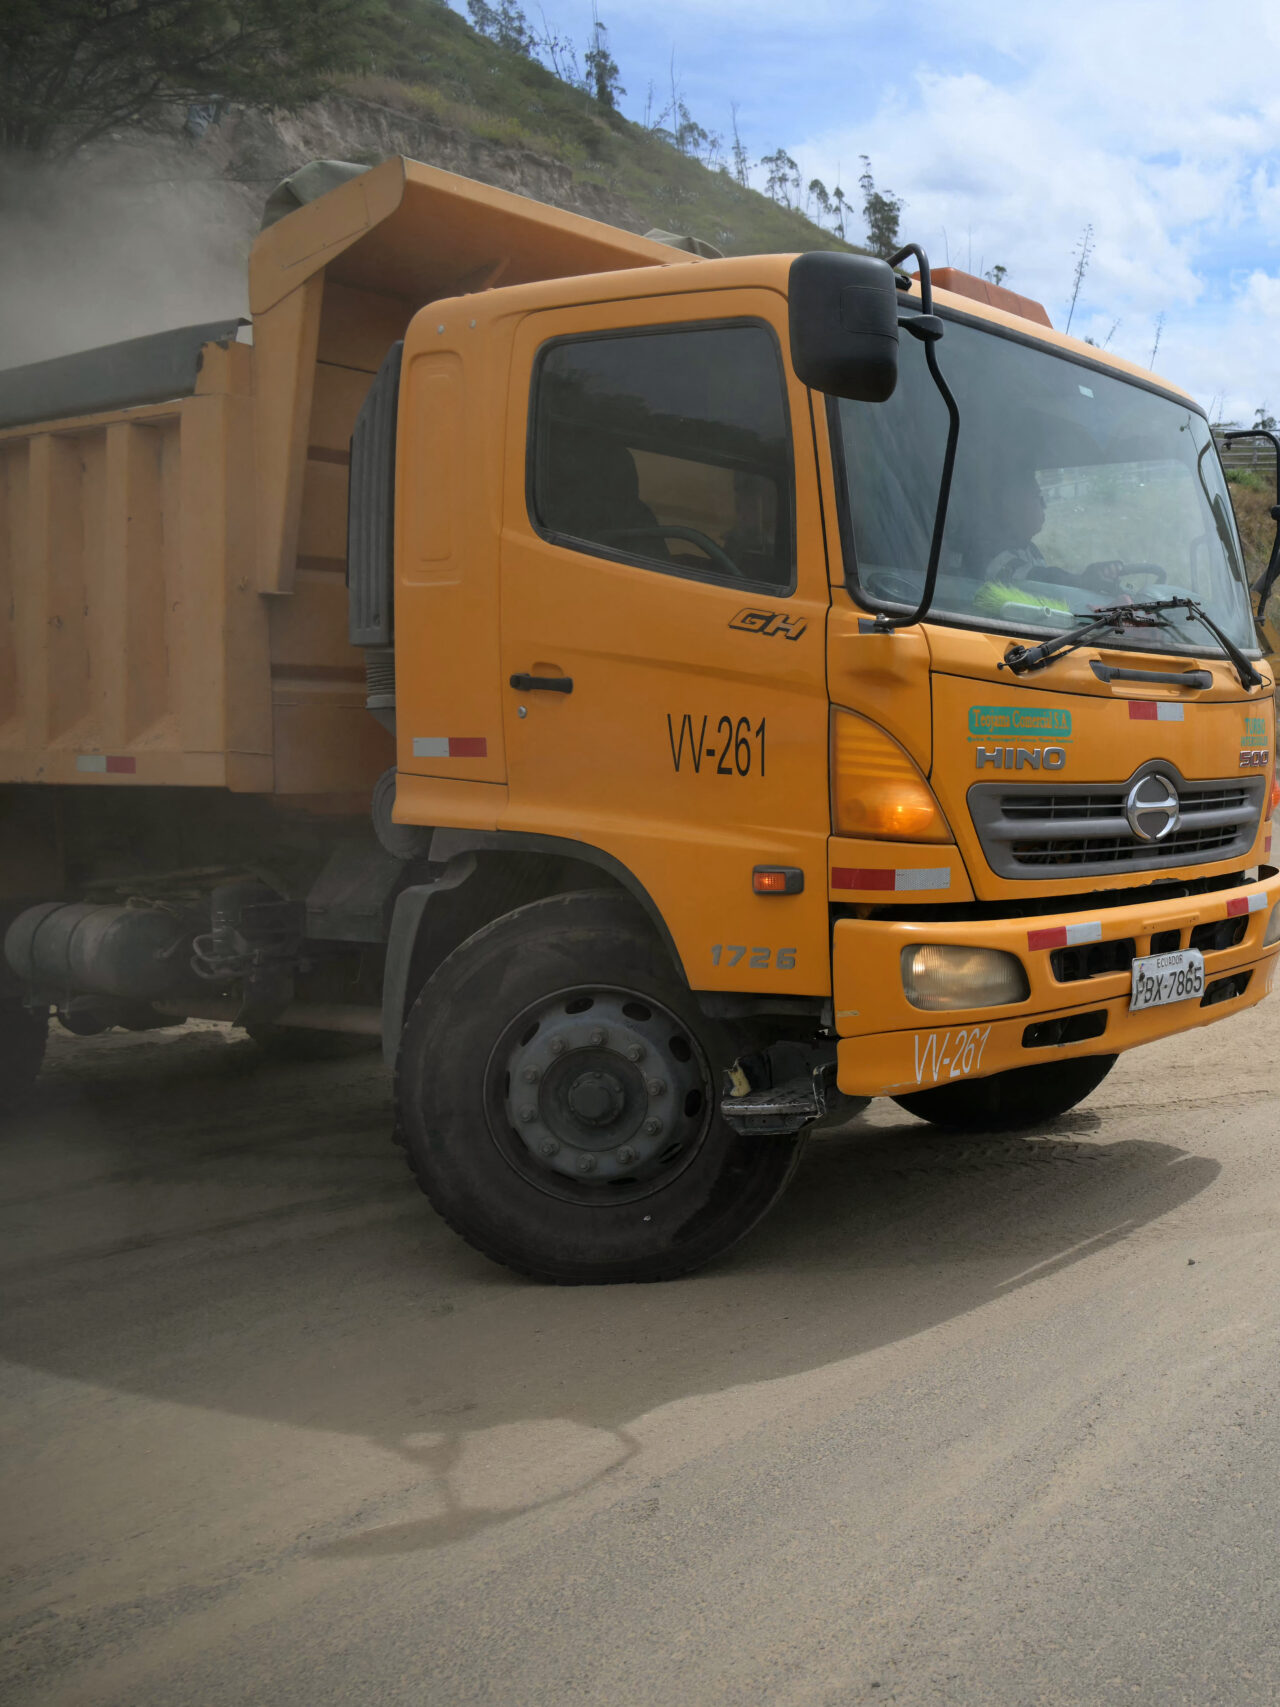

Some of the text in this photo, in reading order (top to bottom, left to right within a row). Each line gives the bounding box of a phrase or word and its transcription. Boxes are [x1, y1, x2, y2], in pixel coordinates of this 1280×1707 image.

[728, 607, 808, 641] GH
[976, 746, 1066, 770] HINO
[1239, 750, 1269, 768] 500
[711, 943, 797, 970] 1726
[1156, 953, 1184, 969] ECUADOR
[1134, 966, 1203, 1006] PBX-7865
